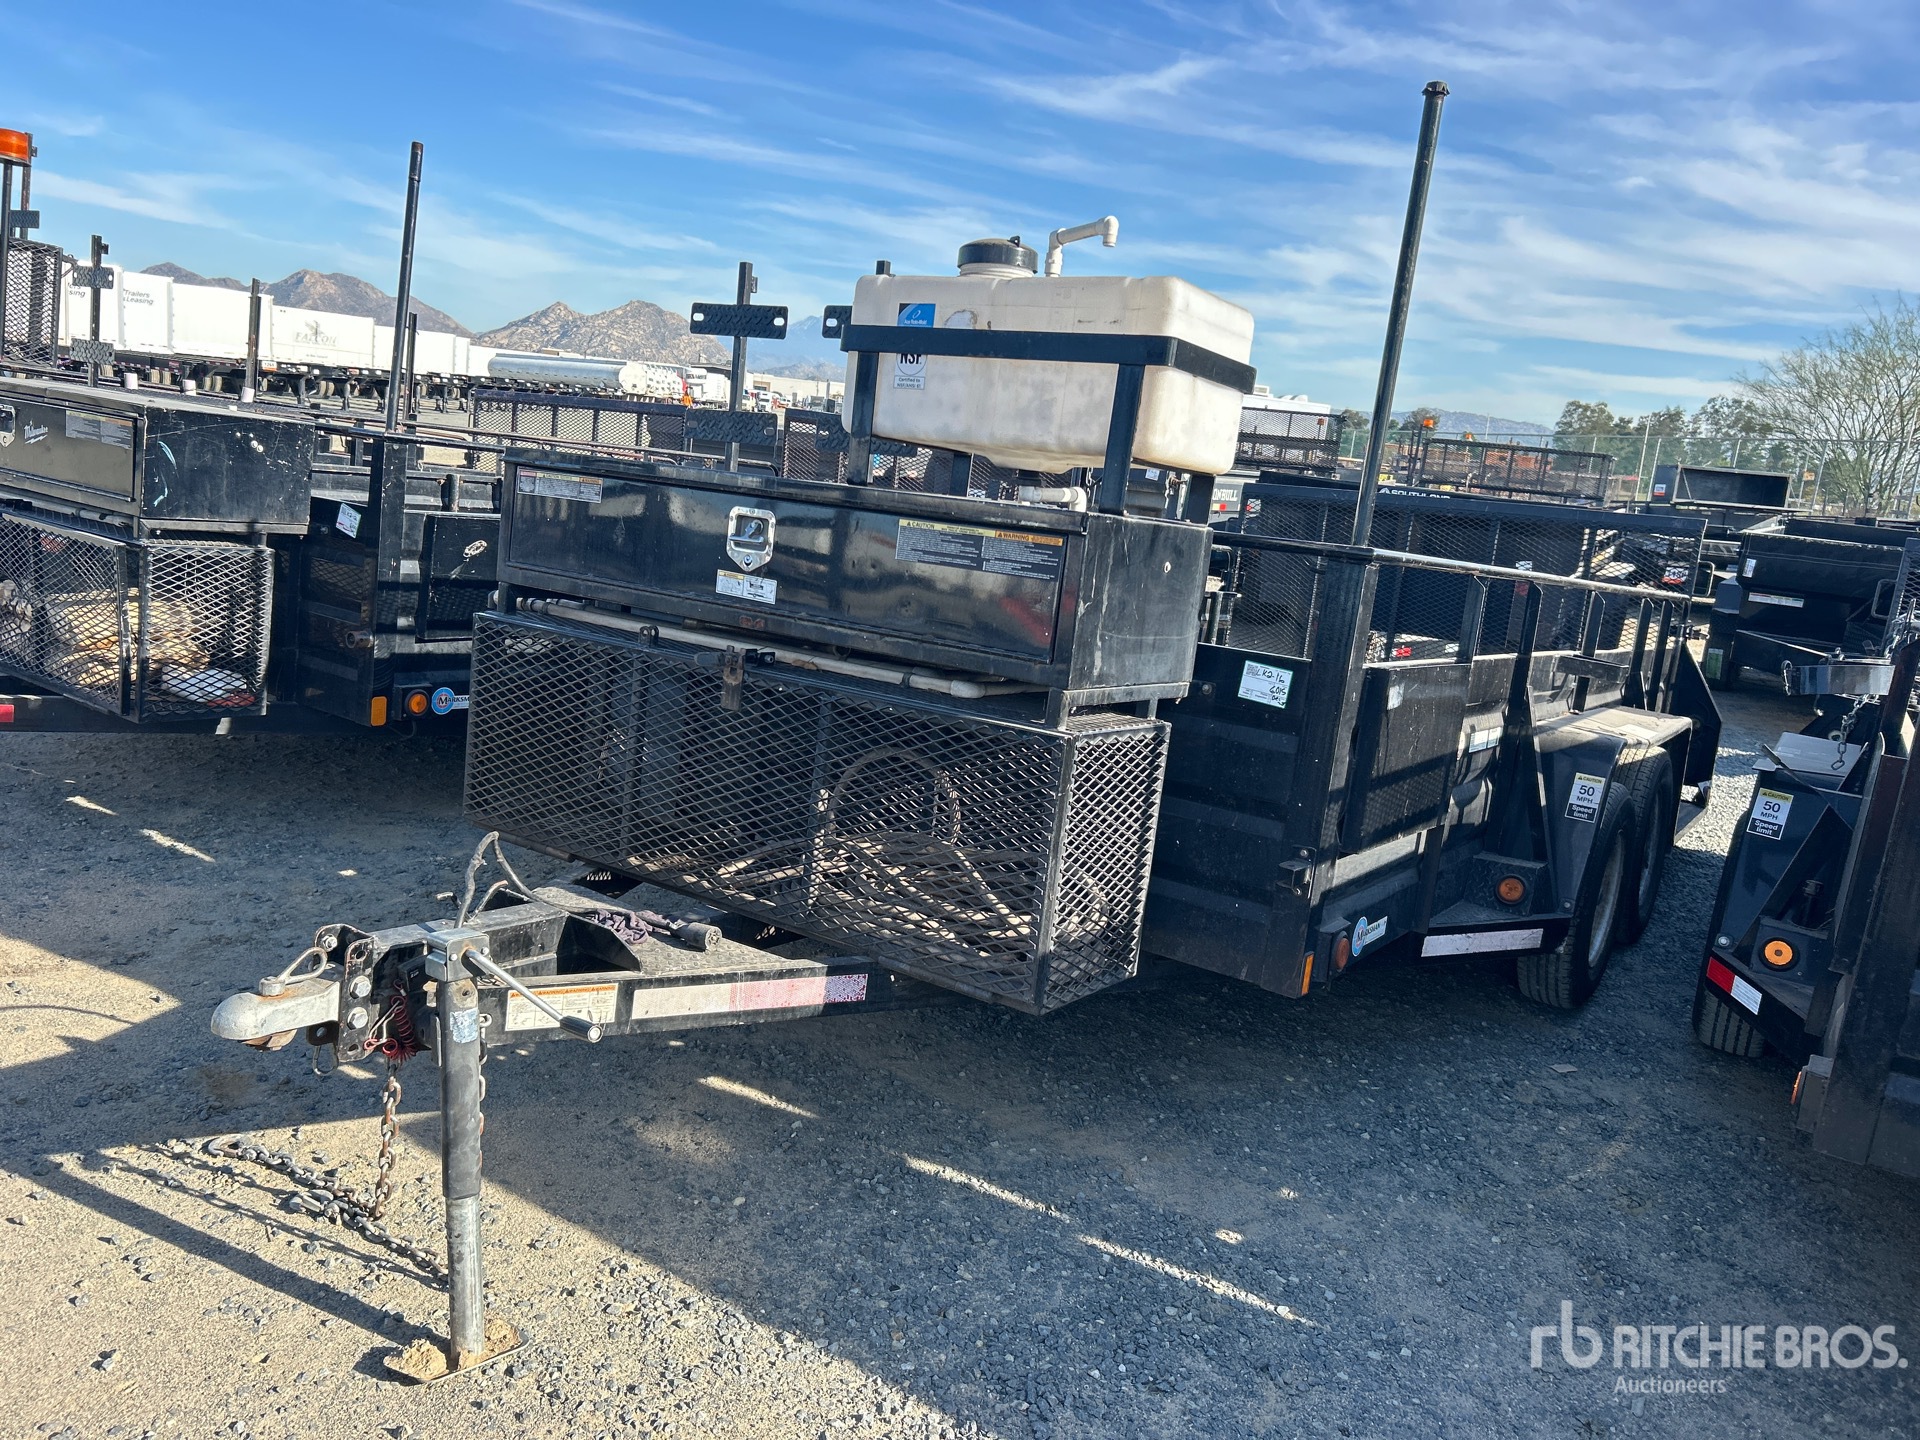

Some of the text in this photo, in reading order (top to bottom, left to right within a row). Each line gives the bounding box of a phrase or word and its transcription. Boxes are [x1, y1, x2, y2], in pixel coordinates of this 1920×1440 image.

[125, 289, 151, 299] Trailers
[126, 297, 154, 306] Leasing
[295, 332, 337, 344] FALCON
[1212, 488, 1238, 501] ONBULL
[912, 522, 935, 530] CAUTION
[1003, 533, 1030, 541] WARNING
[439, 697, 470, 705] MARKSM
[1583, 776, 1602, 784] CAUTION
[1579, 785, 1595, 796] 50
[1576, 796, 1593, 804] MPH
[1768, 792, 1789, 801] CAUTION
[1572, 805, 1593, 814] Speed
[1763, 800, 1781, 813] 50
[1573, 811, 1588, 819] limit
[1760, 811, 1779, 820] MPH
[1754, 820, 1778, 831] Speed
[1756, 827, 1773, 835] limit
